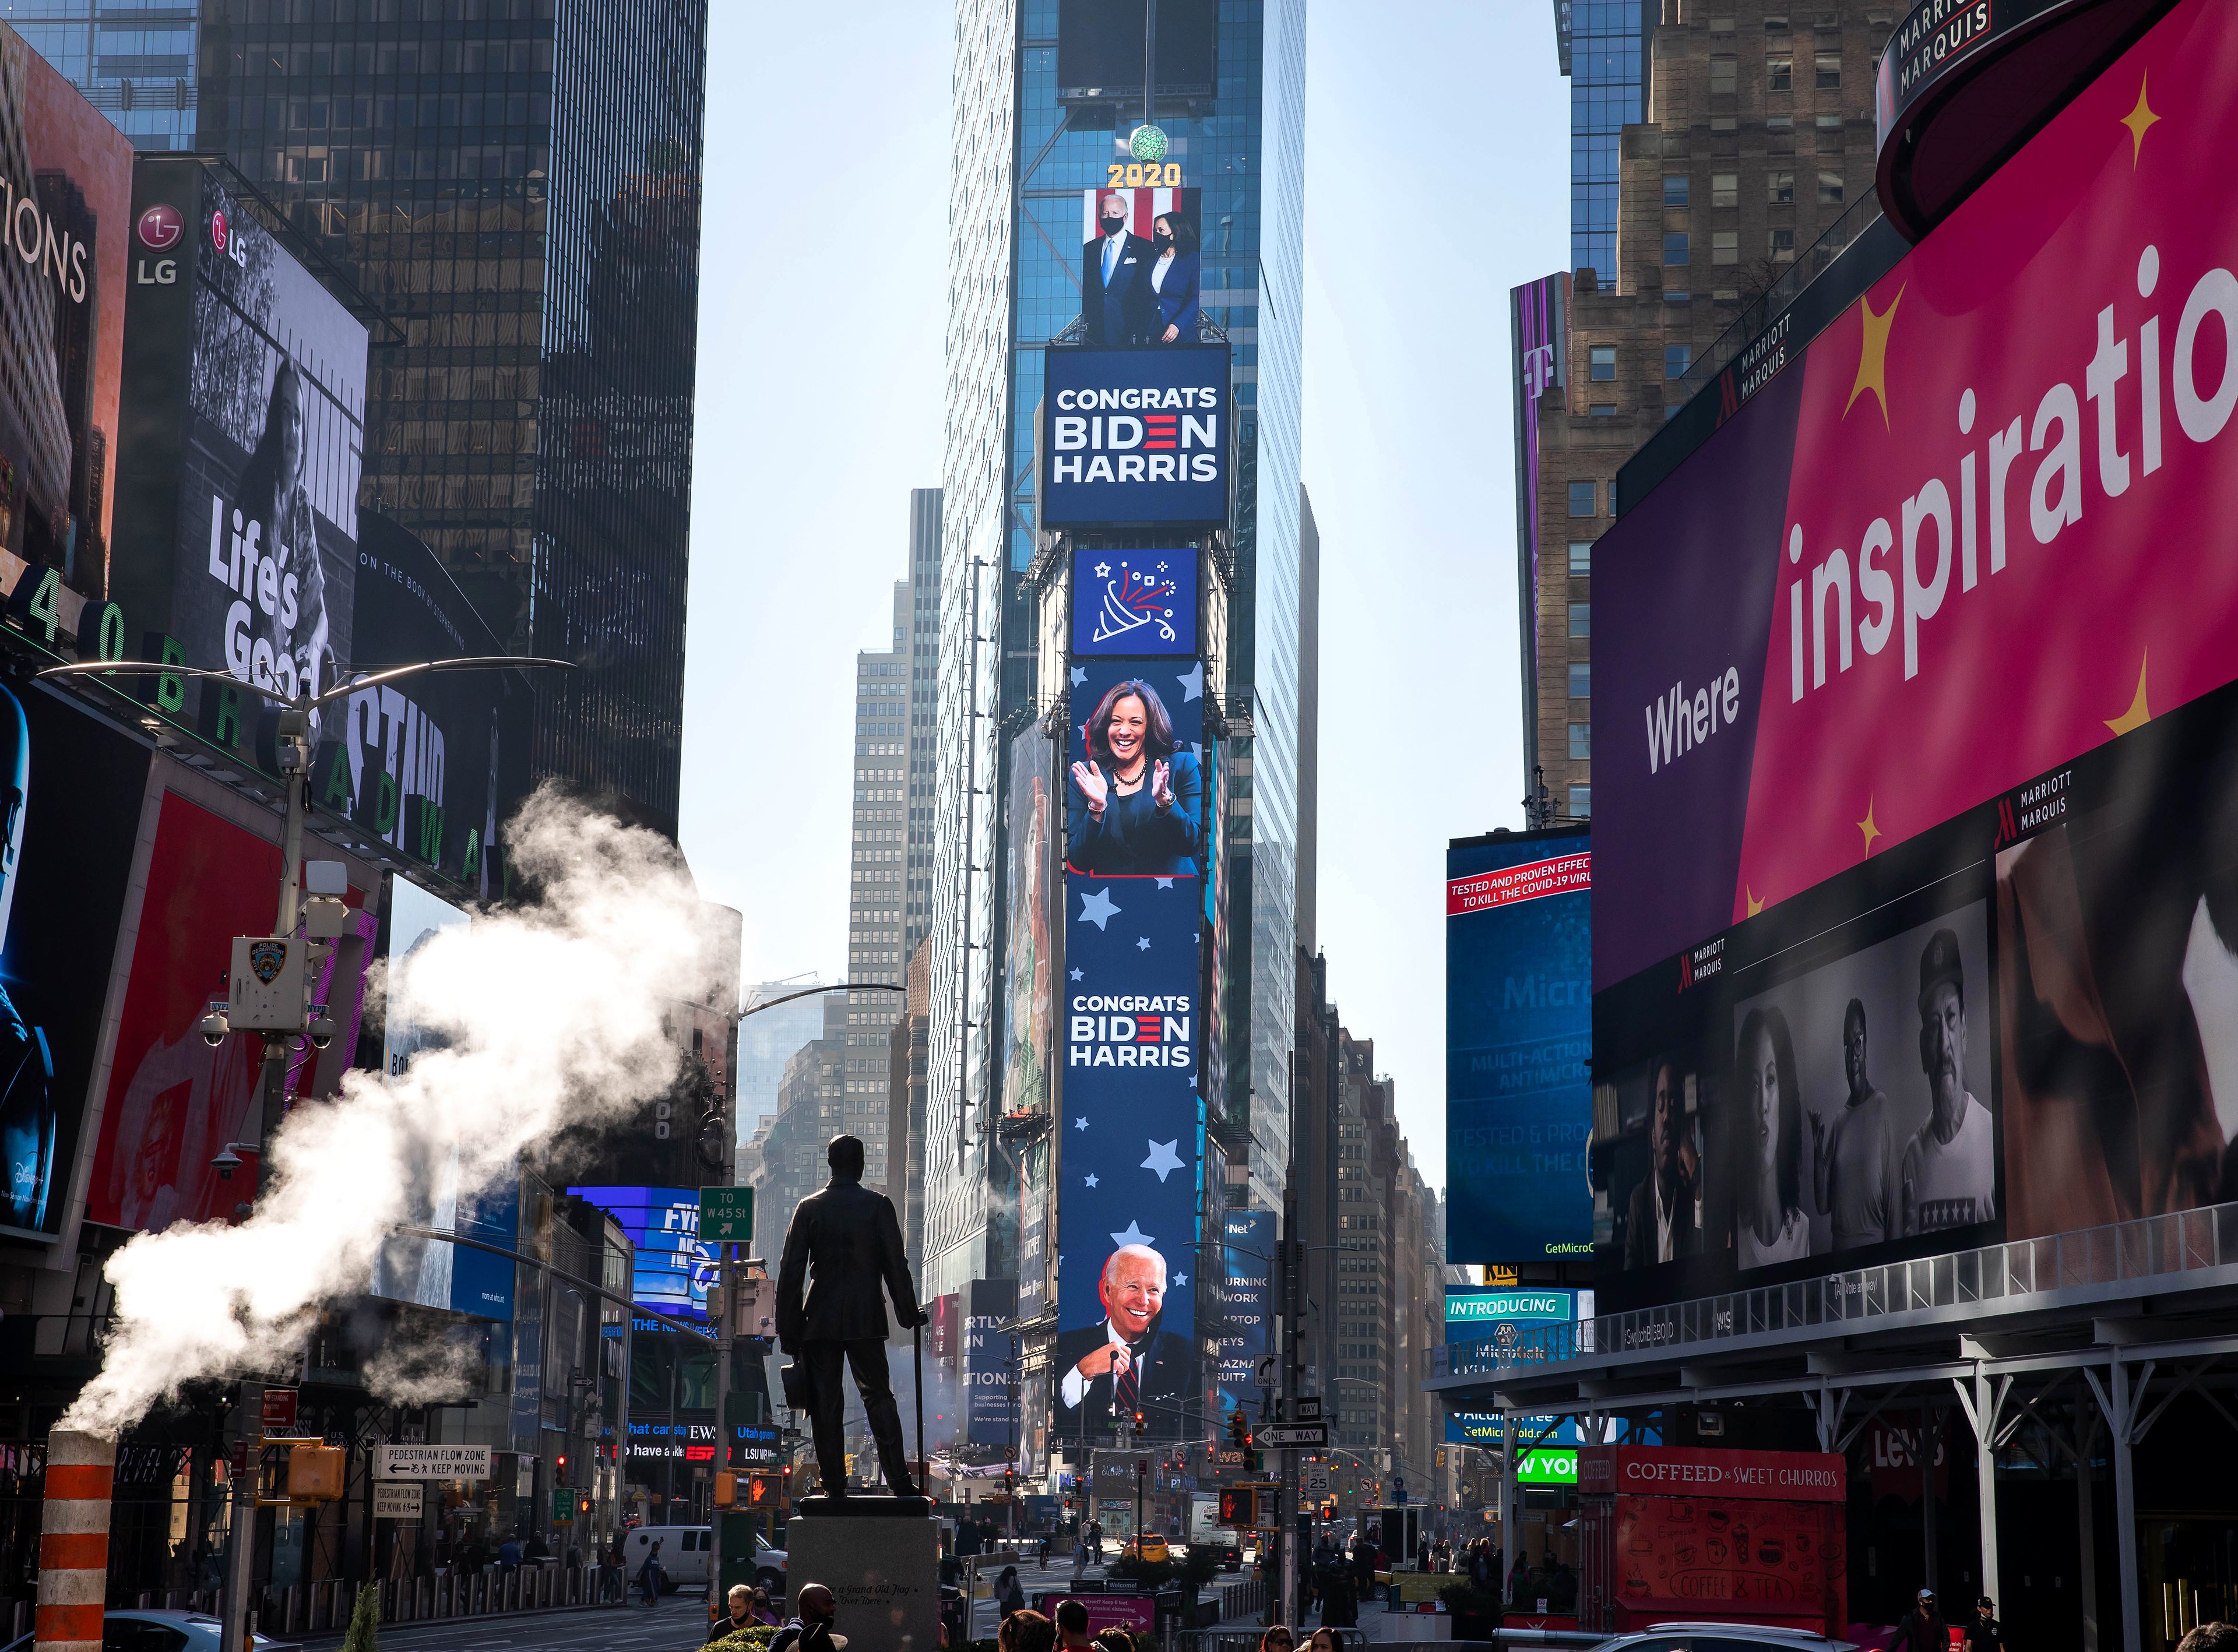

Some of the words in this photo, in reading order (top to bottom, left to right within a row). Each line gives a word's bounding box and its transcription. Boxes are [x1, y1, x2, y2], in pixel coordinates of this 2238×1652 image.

[1901, 0, 1965, 58] MARRI
[1901, 3, 1987, 96] MARQUIS
[1108, 163, 1180, 188] 2020
[0, 176, 86, 304] IONS
[228, 229, 245, 268] LG
[138, 260, 176, 284] LG
[1741, 314, 1792, 369] MARRIOTT
[1741, 346, 1786, 400] MARQUIS
[1057, 387, 1217, 410] CONGRATS
[1054, 414, 1216, 450] BIDEN
[1054, 453, 1217, 484] HARRIS
[209, 495, 298, 629] Life's
[360, 553, 377, 570] ON
[384, 562, 403, 583] THE
[407, 576, 425, 601] BOOK
[427, 594, 432, 610] BY
[434, 604, 453, 636] STEPHEN
[454, 629, 465, 651] KING
[1645, 667, 1739, 774] Where
[2021, 770, 2072, 808] MARRIOTT
[2021, 797, 2066, 830] MARQUIS
[1452, 880, 1489, 896] TESTED
[1490, 876, 1512, 889] AND
[1514, 865, 1555, 884] PROVEN
[1558, 858, 1591, 873] EFFEC
[1463, 897, 1476, 907] TO
[1478, 893, 1498, 905] KILL
[1500, 887, 1520, 900] THE
[1522, 876, 1568, 894] COVID-19
[252, 947, 284, 956] DEPARTMENT
[1694, 938, 1725, 963] MARRIOTT
[269, 971, 277, 980] NEW
[1694, 959, 1722, 980] MARQUIS
[307, 1005, 326, 1013] NYPD
[1072, 995, 1190, 1013] CONGRATS
[1071, 1016, 1190, 1042] BIDEN
[1070, 1045, 1190, 1067] HARRIS
[720, 1193, 733, 1203] TO
[708, 1209, 716, 1218] W
[717, 1209, 733, 1218] 45
[736, 1208, 746, 1218] St
[1845, 1282, 1856, 1294] Vote
[1451, 1298, 1556, 1316] INTRODUCING
[632, 1319, 659, 1332] THE
[935, 1325, 944, 1336] ARE
[1301, 1404, 1316, 1415] WAY
[674, 1424, 687, 1438] stop
[737, 1426, 758, 1438] Utah
[1264, 1431, 1285, 1441] ONE
[1296, 1431, 1318, 1440] WAY
[389, 1450, 438, 1460] PEDESTRIAN
[441, 1450, 462, 1460] FLOW
[465, 1450, 485, 1460] ZONE
[634, 1445, 662, 1456] have
[745, 1448, 759, 1460] LSU
[431, 1464, 451, 1474] KEEP
[454, 1464, 485, 1474] MOVING
[1584, 1459, 1610, 1480] COFFEED
[1627, 1463, 1722, 1482] COFFEED
[1725, 1471, 1732, 1480] &
[1733, 1467, 1774, 1485] SWEET
[1779, 1469, 1838, 1487] CHURROS
[378, 1488, 400, 1498] PEDESTRIAN
[401, 1489, 410, 1499] FLOW
[411, 1489, 421, 1499] ZONE
[1310, 1478, 1327, 1489] 25
[377, 1502, 386, 1512] KEEP
[387, 1502, 401, 1512] MOVING
[875, 1584, 889, 1594] Old
[1681, 1576, 1726, 1597] COFFEE
[1735, 1576, 1748, 1598] &
[1753, 1578, 1783, 1599] TEA
